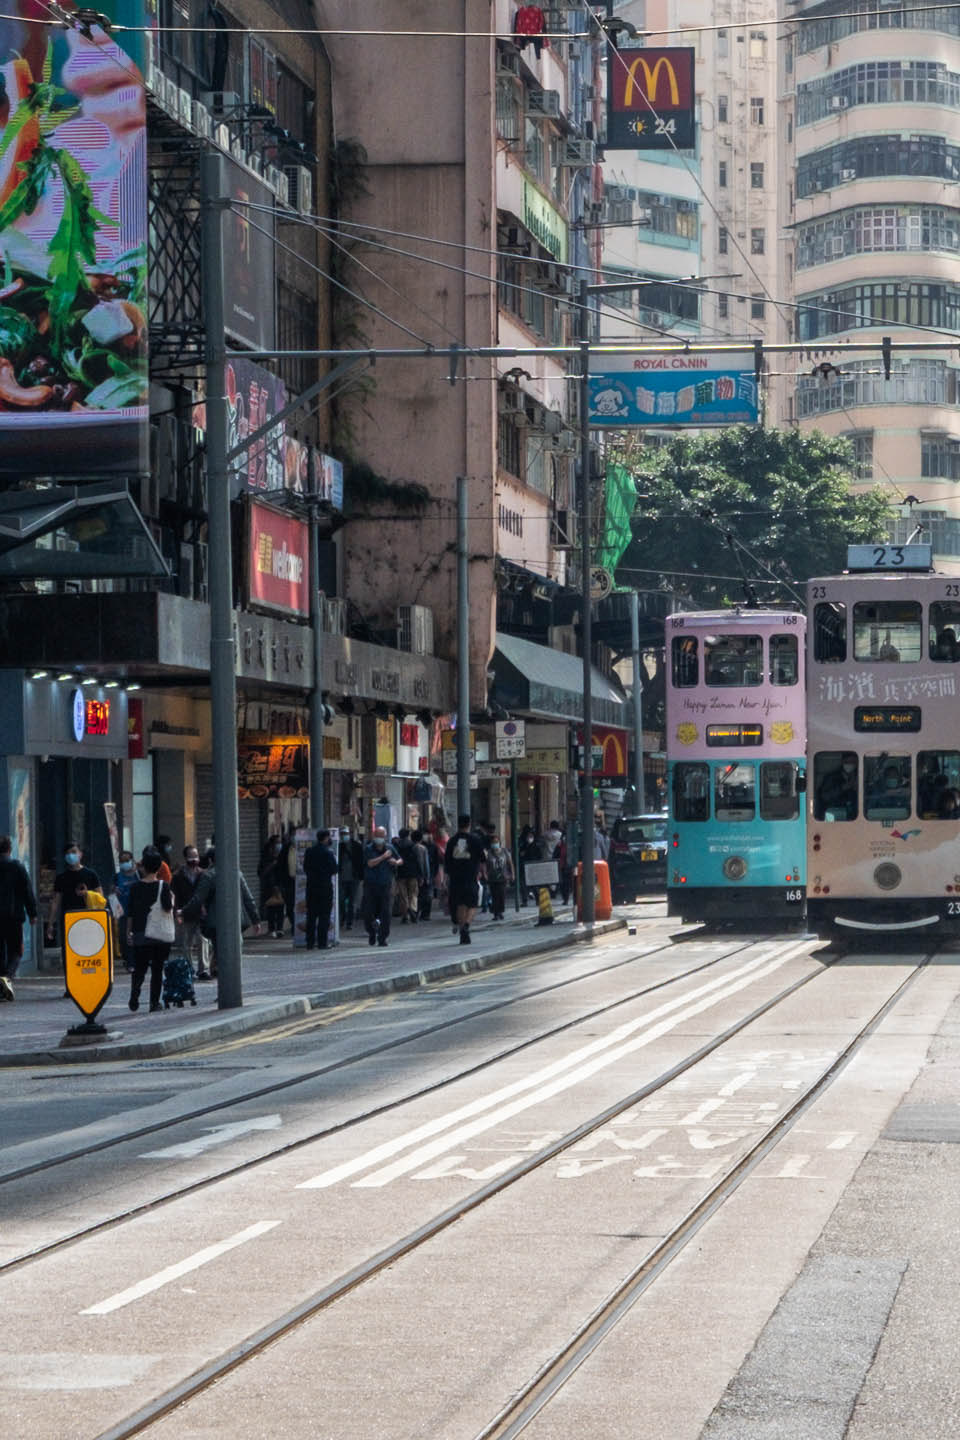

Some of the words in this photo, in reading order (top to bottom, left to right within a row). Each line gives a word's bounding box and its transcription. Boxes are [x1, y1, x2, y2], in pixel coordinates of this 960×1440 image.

[654, 118, 677, 135] 24
[633, 358, 669, 370] ROYAL
[671, 358, 708, 369] CANIN
[873, 547, 905, 566] 23
[812, 586, 827, 598] 23
[945, 584, 960, 597] 23
[782, 615, 798, 626] 168
[683, 697, 707, 714] Happy
[863, 714, 884, 723] North
[891, 714, 914, 723] Point
[786, 889, 802, 901] 168
